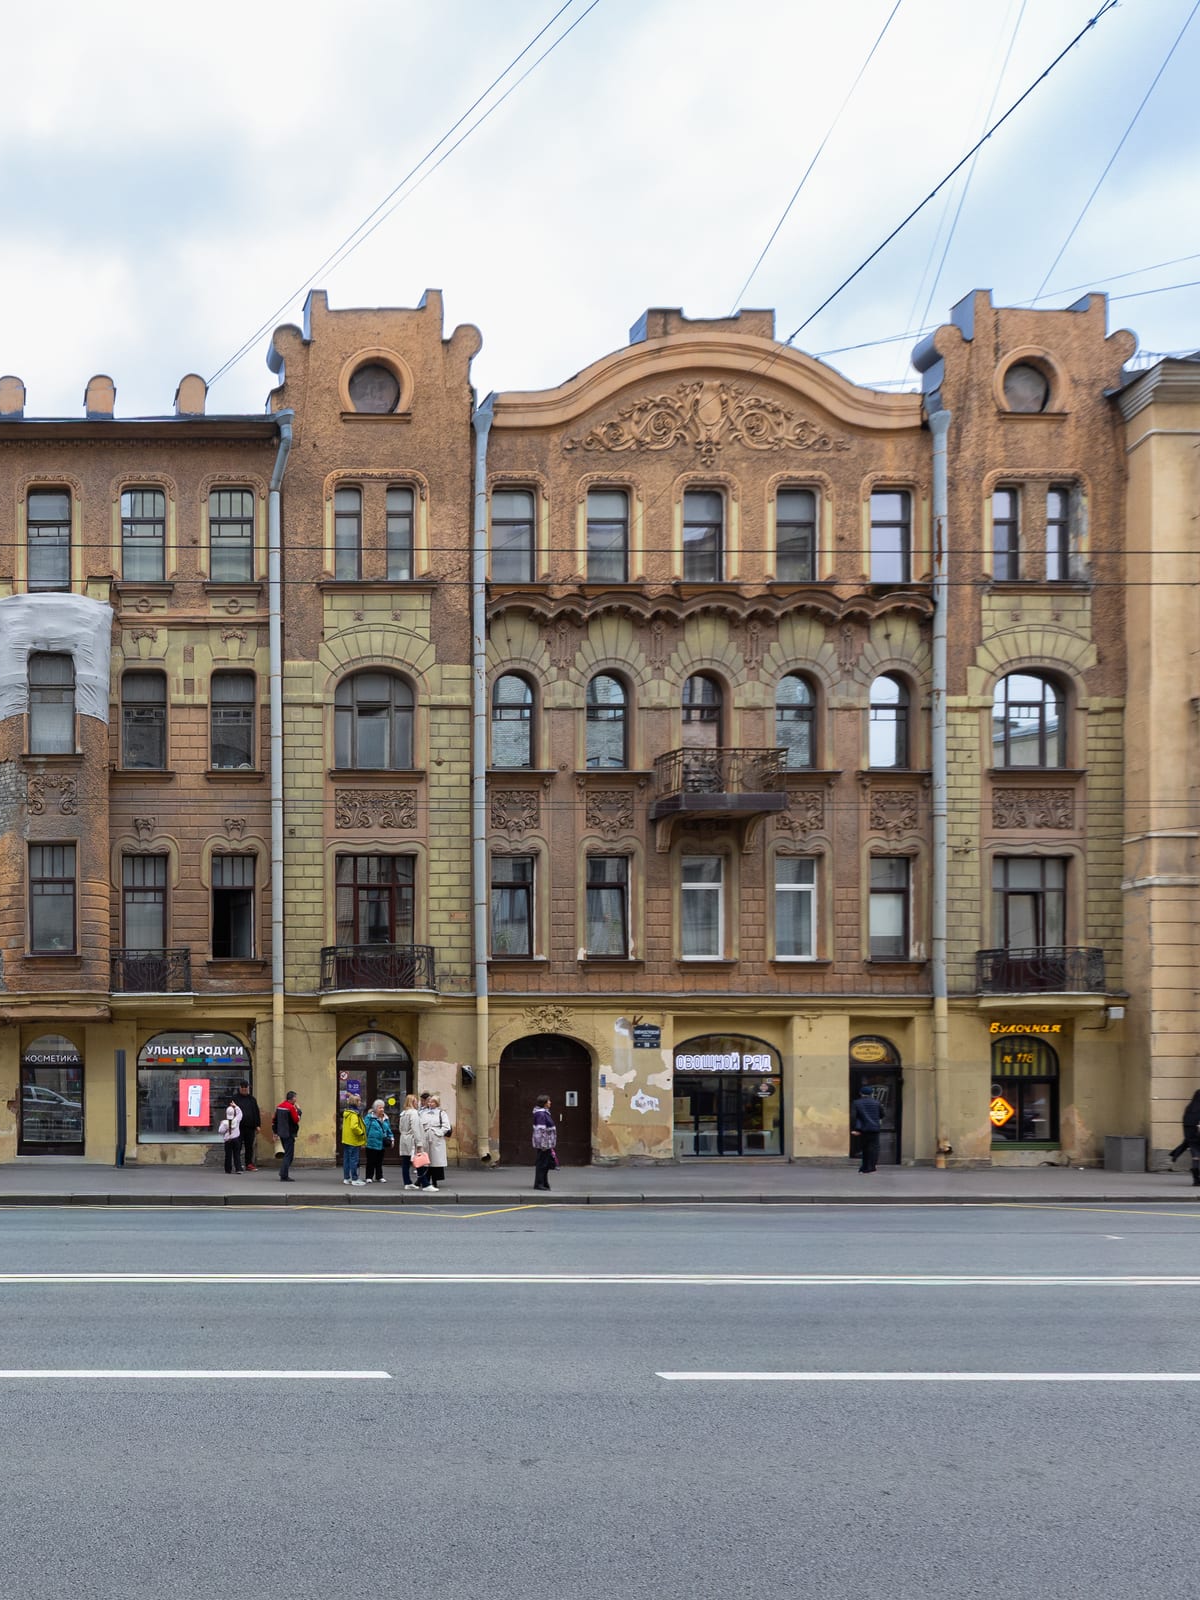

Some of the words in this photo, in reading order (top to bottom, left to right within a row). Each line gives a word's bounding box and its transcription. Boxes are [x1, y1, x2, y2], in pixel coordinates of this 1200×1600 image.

[990, 1022, 1062, 1033] Булочная
[25, 1054, 79, 1063] КОСМЕТИКА
[676, 1052, 740, 1071] ОВОЩНОЙ
[743, 1054, 772, 1071] РЯД
